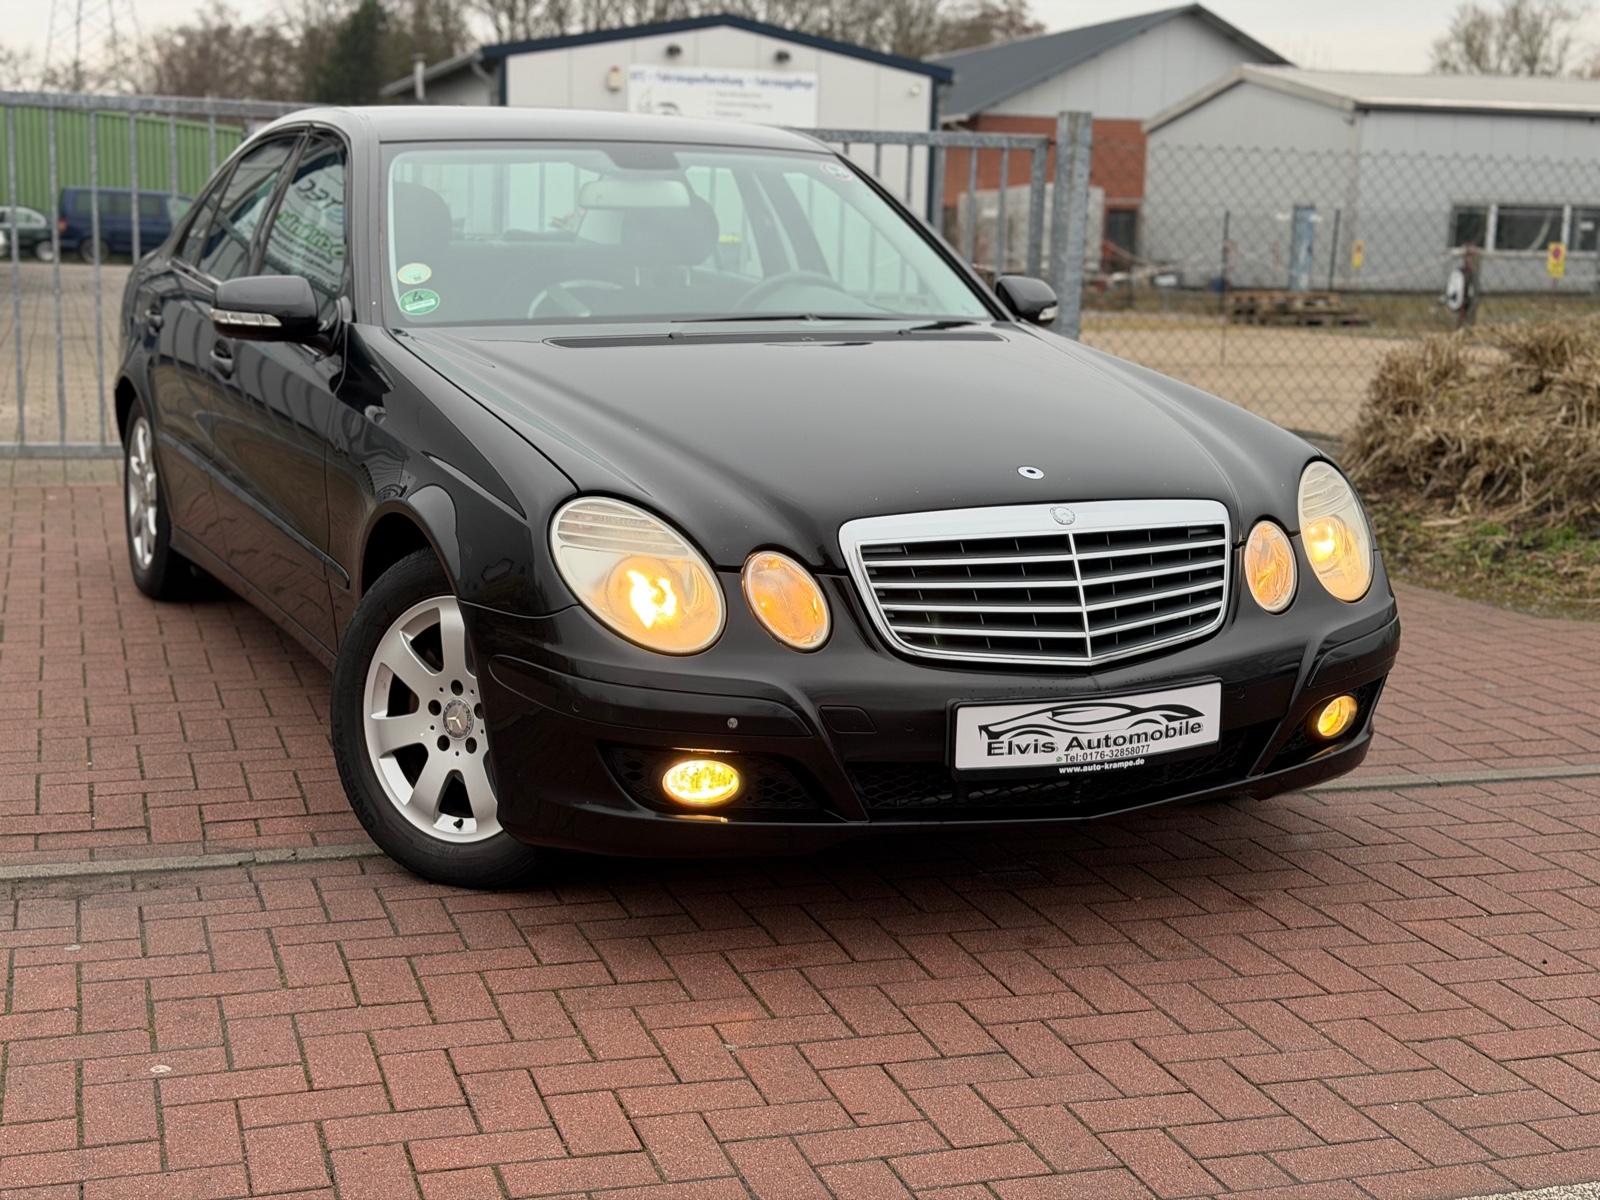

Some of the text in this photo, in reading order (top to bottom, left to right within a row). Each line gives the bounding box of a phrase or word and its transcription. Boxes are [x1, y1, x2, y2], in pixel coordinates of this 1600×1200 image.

[987, 720, 1202, 756] Elvis Automobile
[1064, 744, 1150, 763] Tel:0176-32858077
[1059, 758, 1145, 774] www.auto-krampe.de
